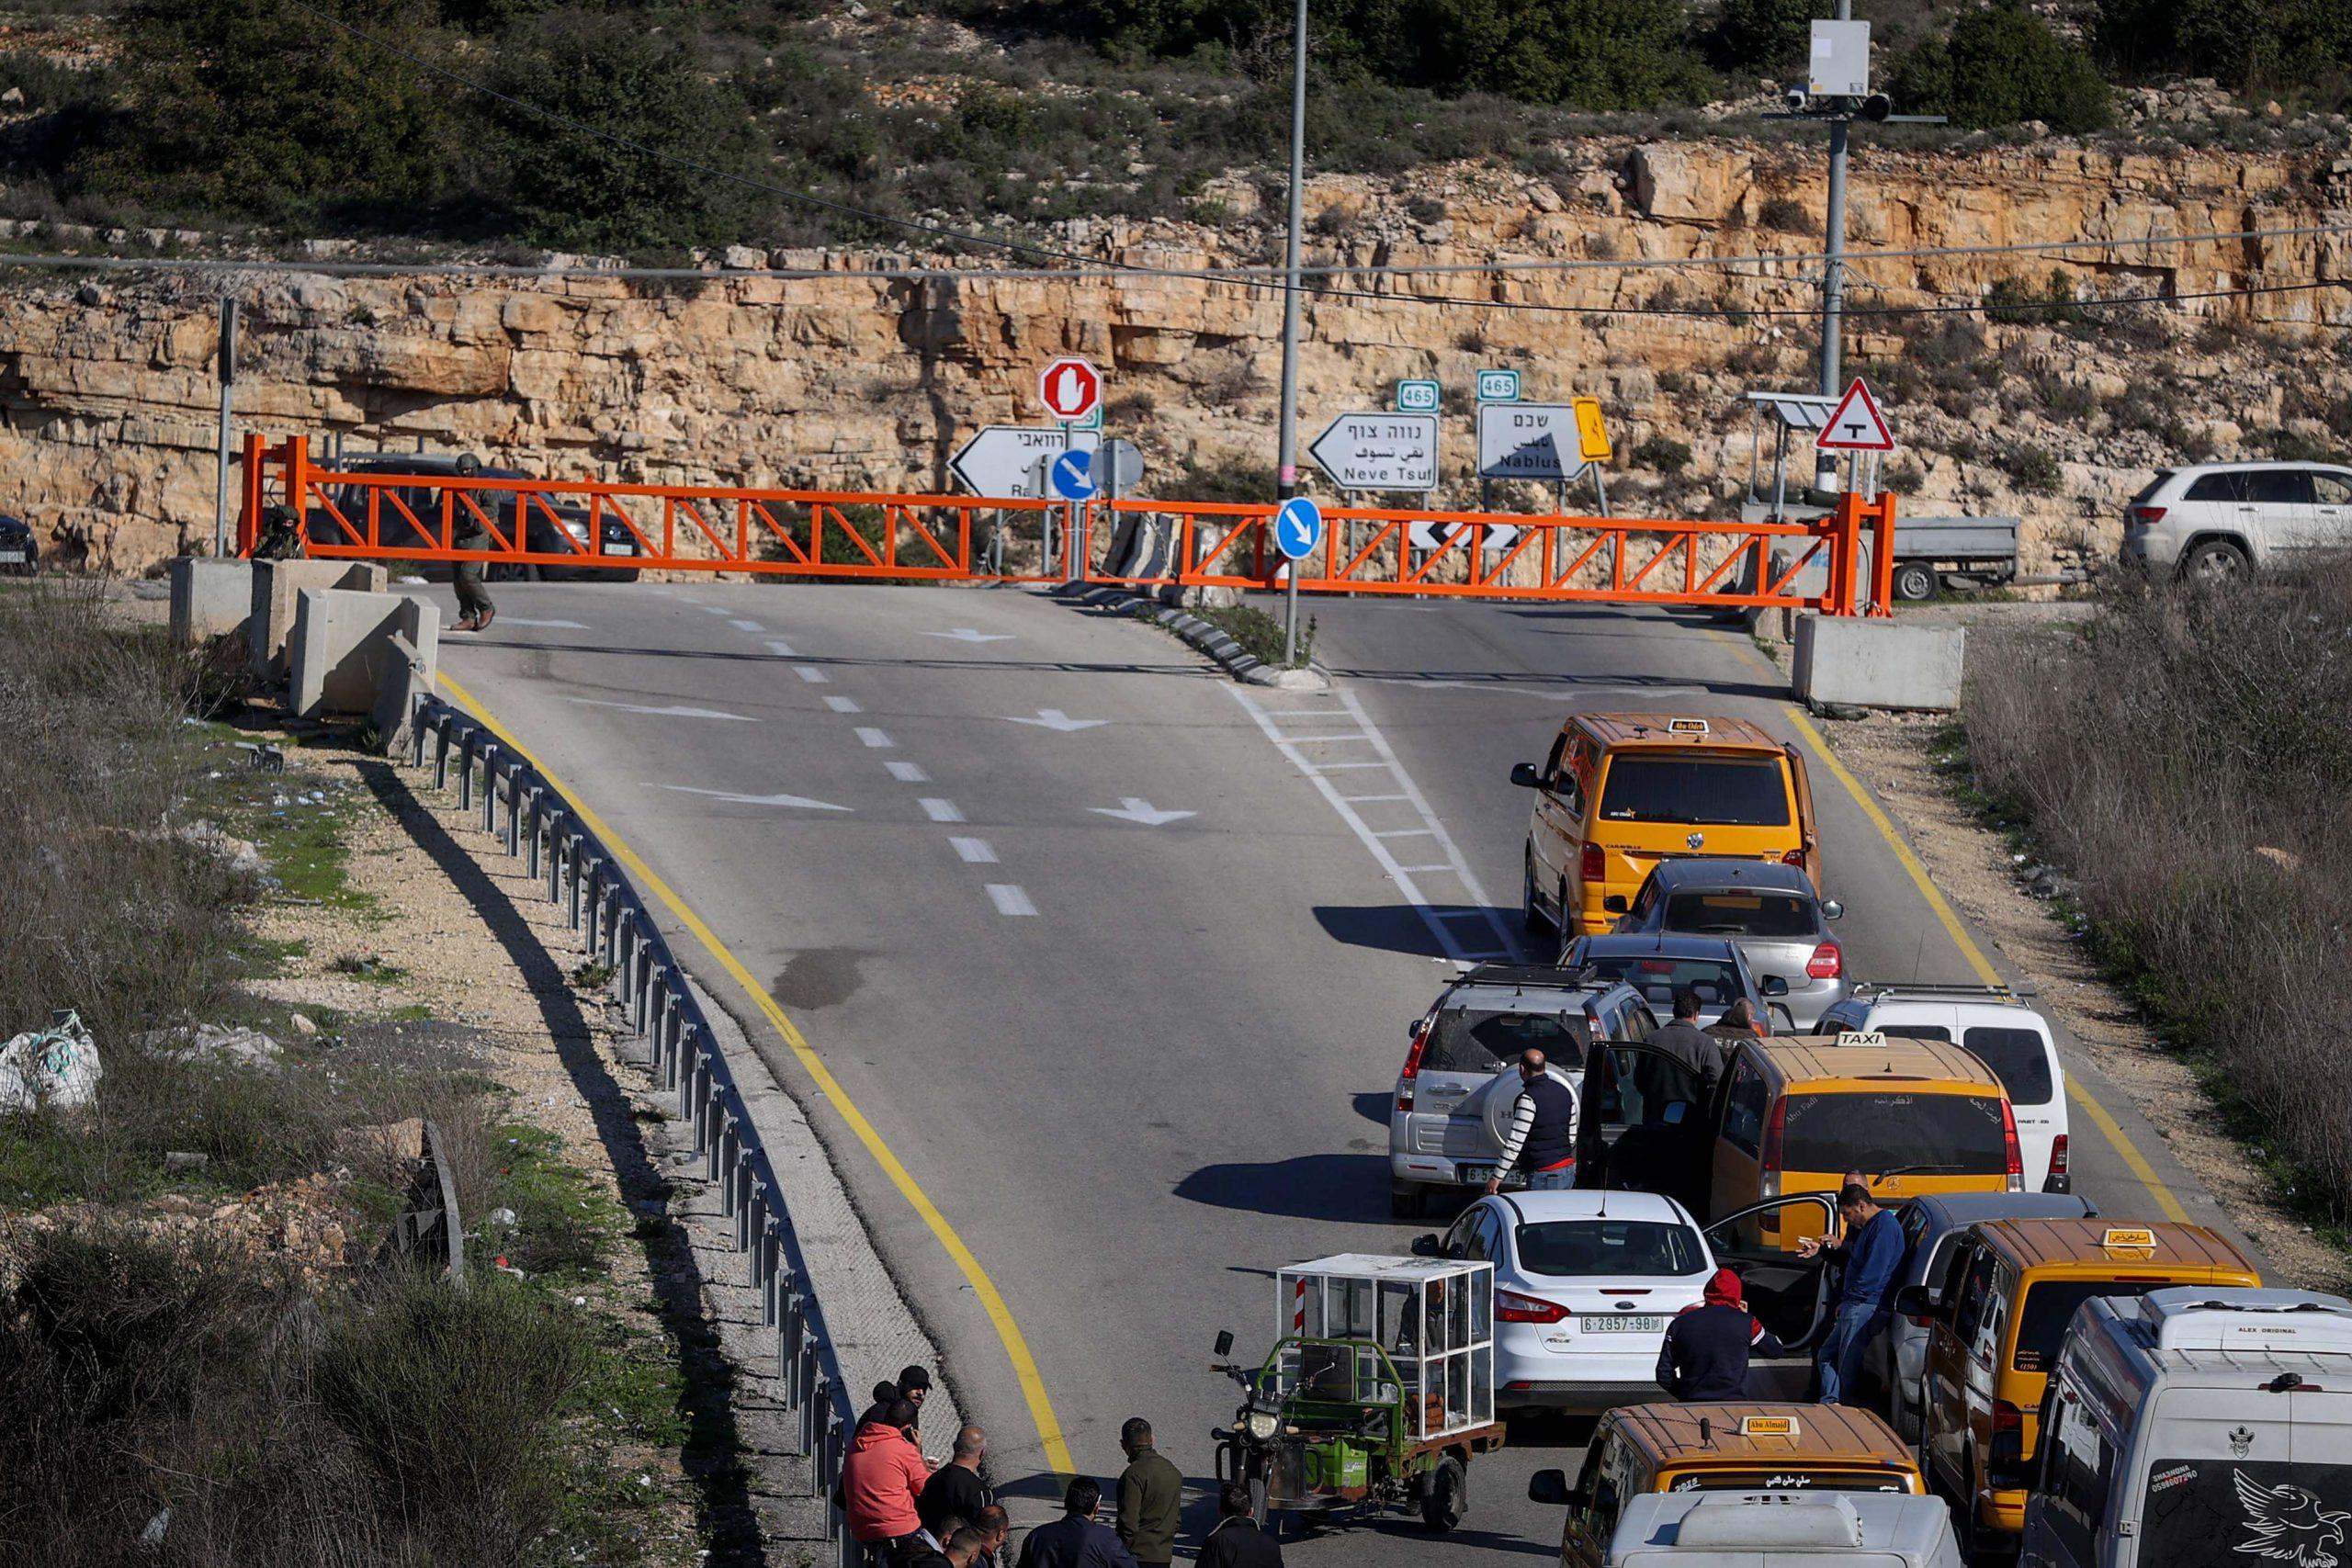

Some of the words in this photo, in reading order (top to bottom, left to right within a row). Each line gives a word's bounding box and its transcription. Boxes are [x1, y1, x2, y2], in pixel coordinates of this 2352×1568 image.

[1485, 380, 1511, 392] 465
[1405, 389, 1431, 402] 465
[1514, 415, 1548, 427] שכם
[1349, 425, 1377, 440] צוף
[1387, 426, 1421, 439] נווה
[1017, 434, 1064, 447] רוואבי
[1500, 456, 1560, 468] Nablus
[1345, 468, 1388, 479] Neve
[1397, 468, 1431, 480] Tsuf
[1841, 1034, 1880, 1043] TAXI
